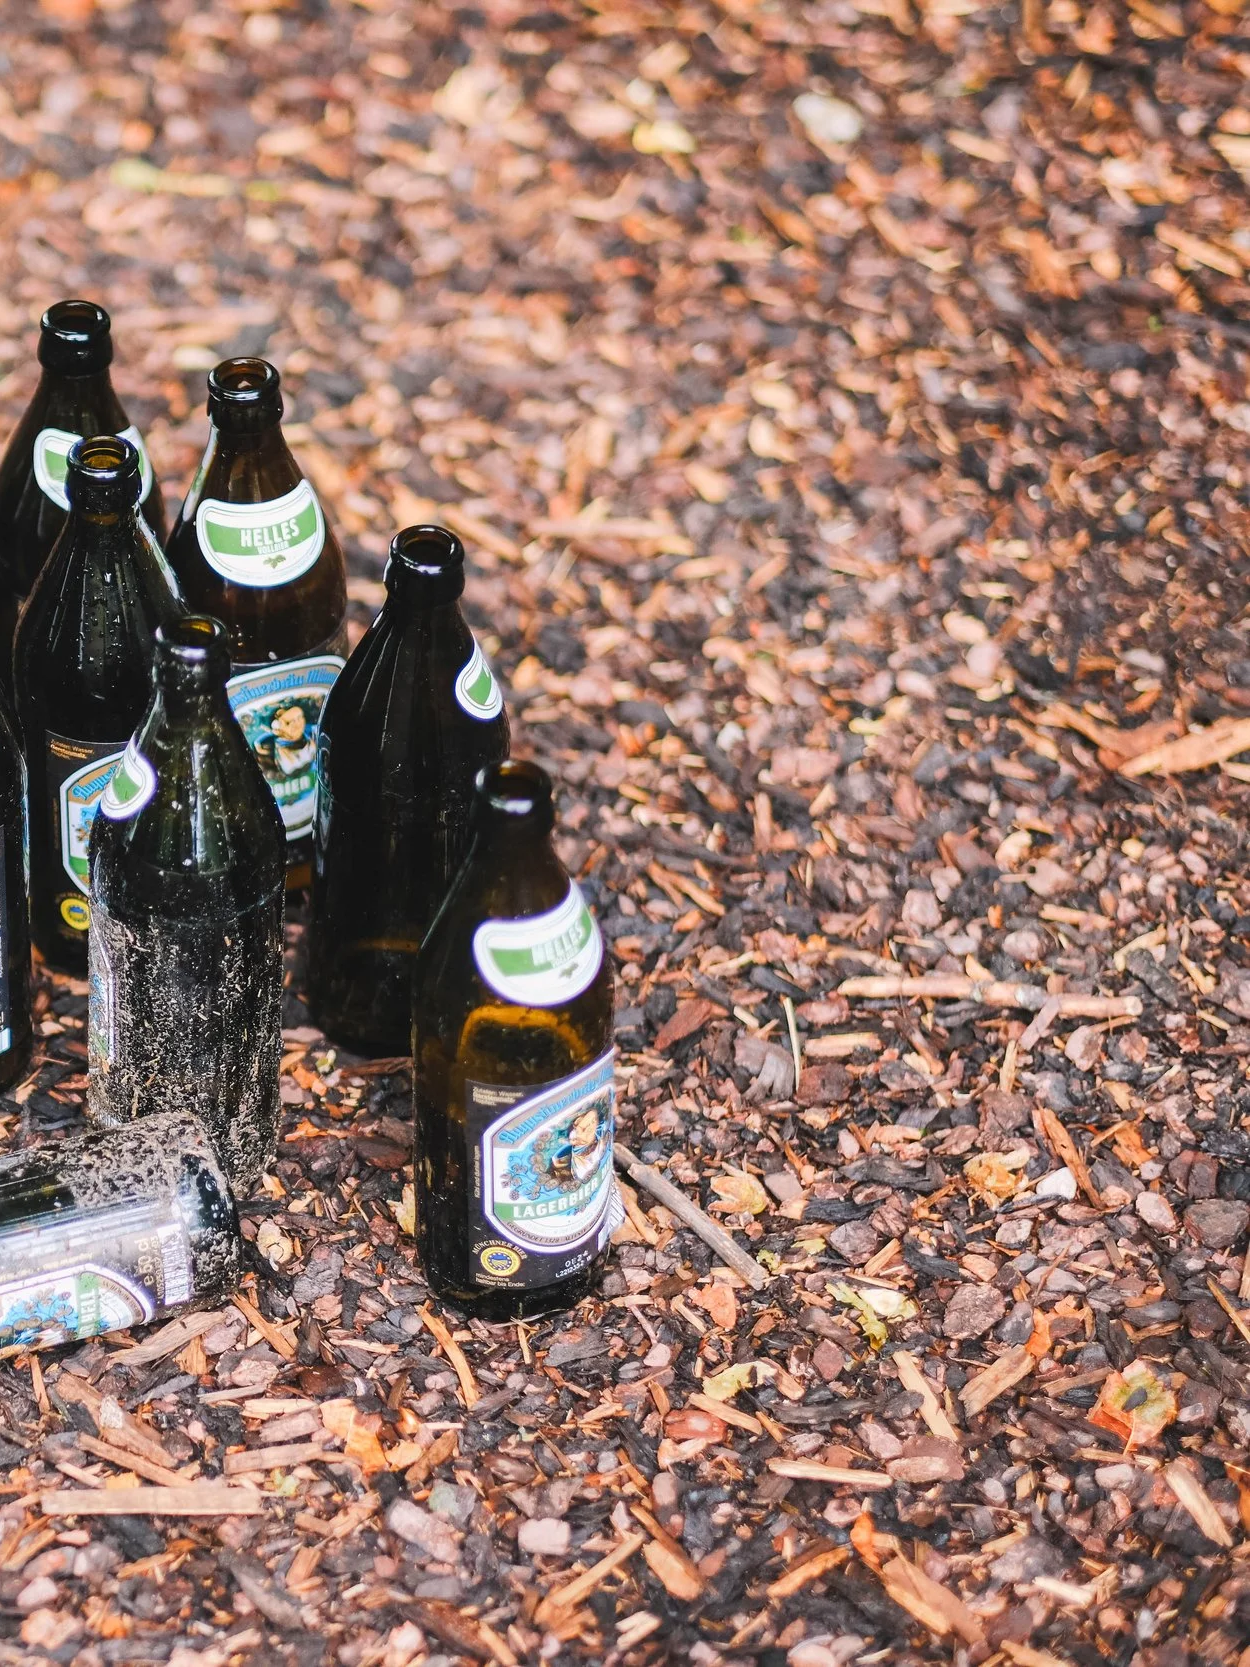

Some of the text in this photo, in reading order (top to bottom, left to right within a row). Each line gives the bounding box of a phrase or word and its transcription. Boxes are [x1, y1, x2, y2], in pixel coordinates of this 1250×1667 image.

[240, 517, 300, 548] HELLES
[513, 1180, 599, 1219] LAGERBIER
[471, 1239, 528, 1260] MÜNCHNER BIER
